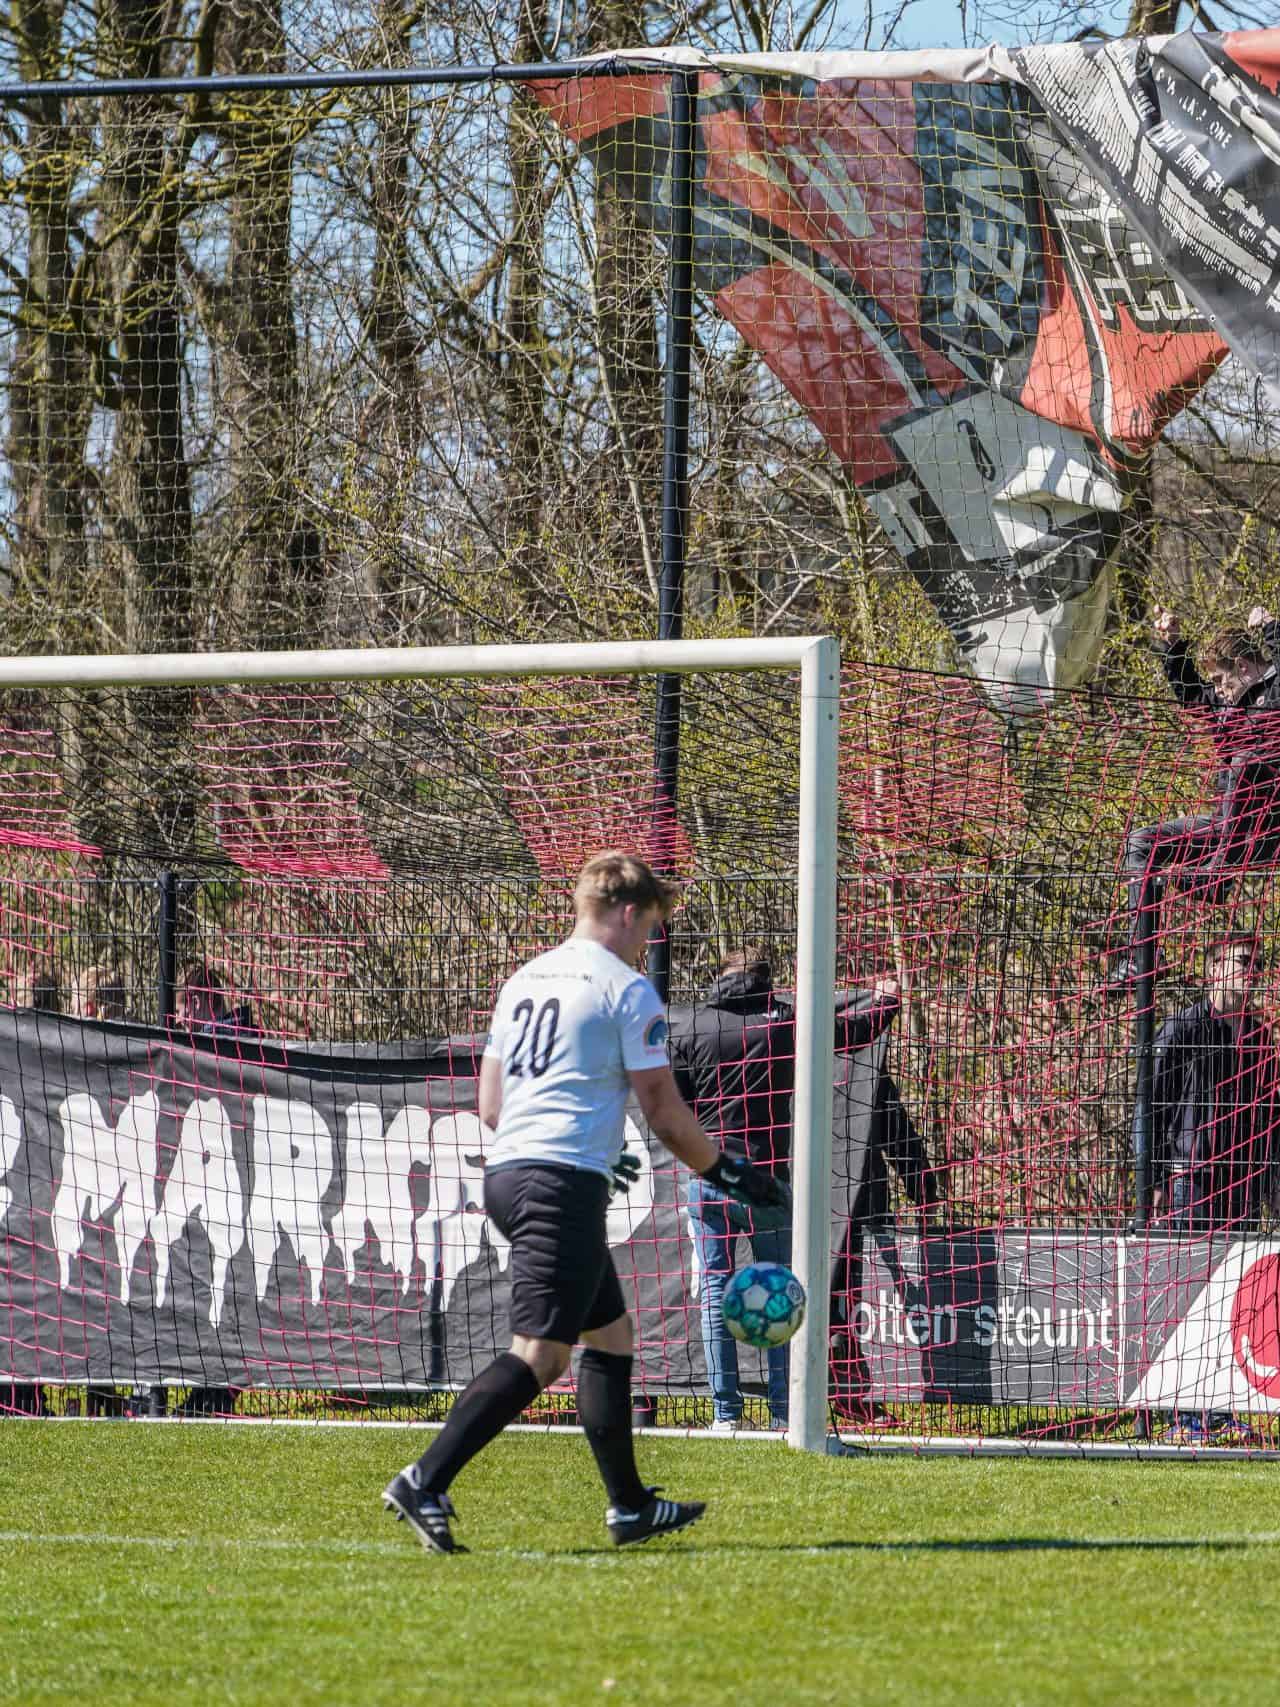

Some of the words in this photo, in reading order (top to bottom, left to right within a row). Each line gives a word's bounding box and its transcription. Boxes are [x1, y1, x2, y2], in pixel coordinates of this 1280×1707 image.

[508, 997, 561, 1079] 20
[837, 1288, 958, 1347] olten
[973, 1293, 1115, 1348] steunt
